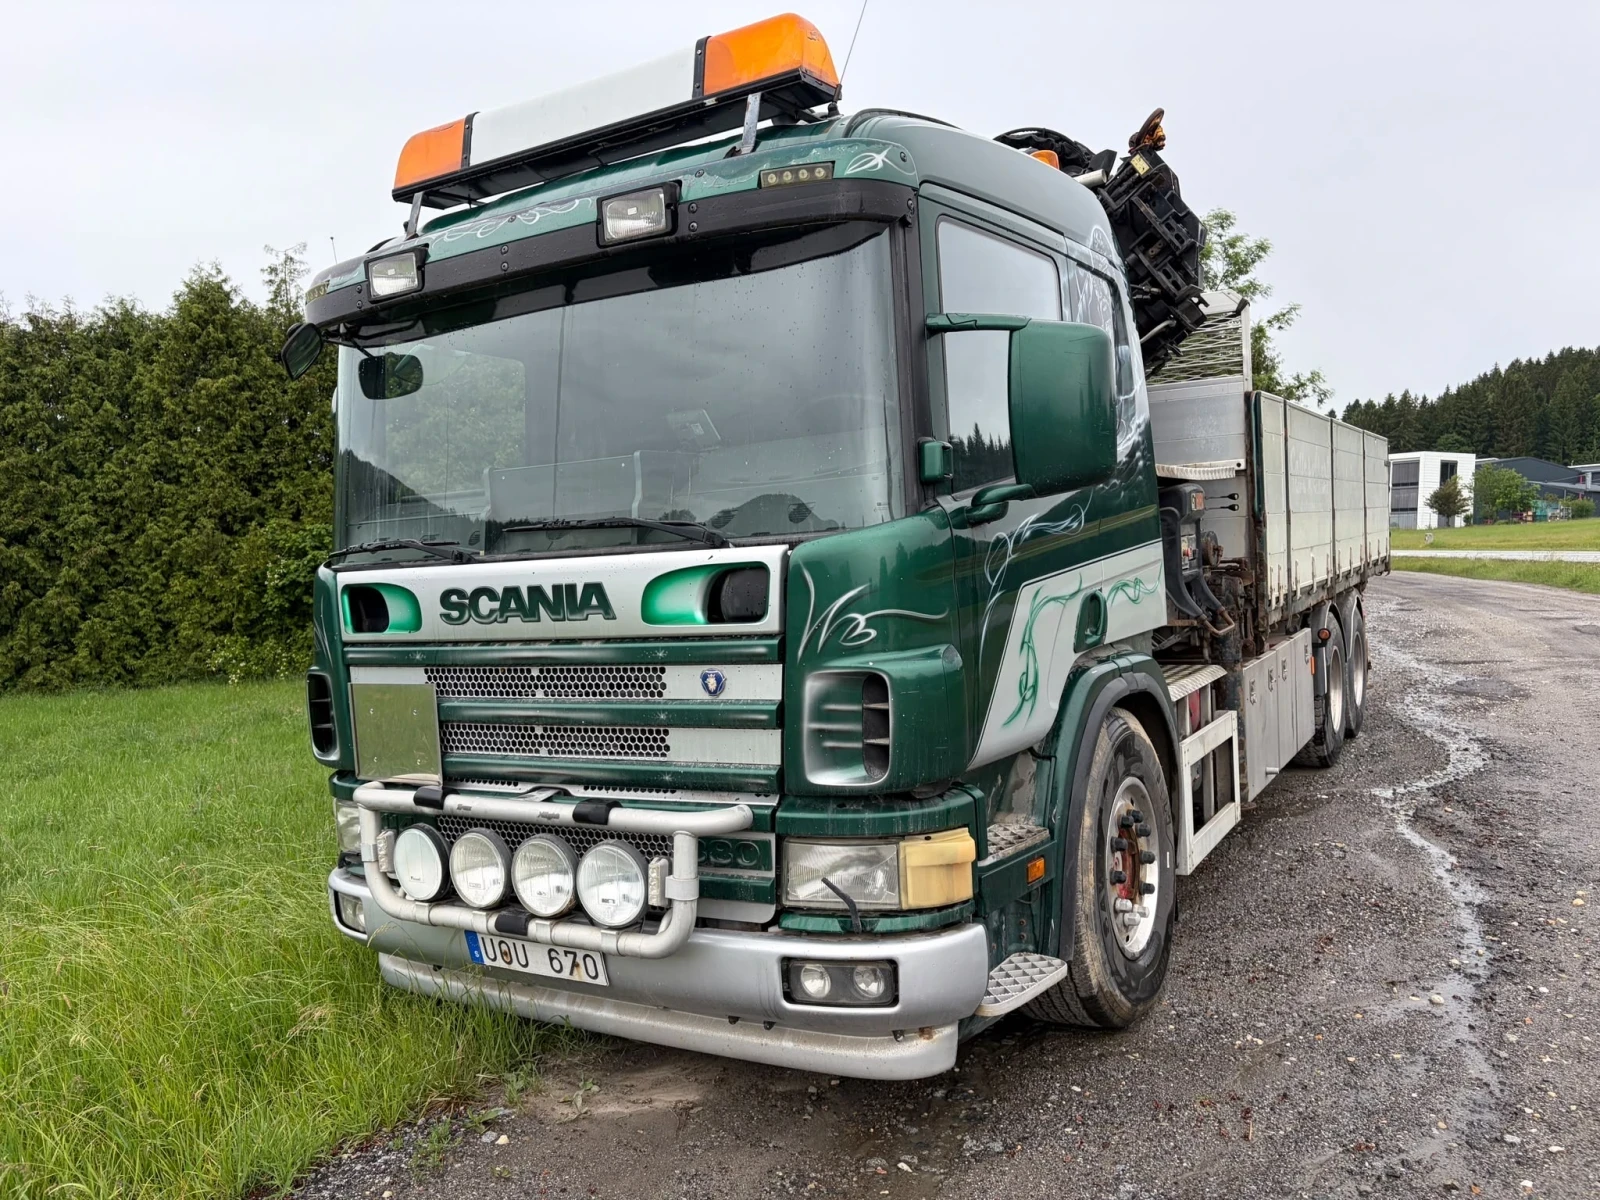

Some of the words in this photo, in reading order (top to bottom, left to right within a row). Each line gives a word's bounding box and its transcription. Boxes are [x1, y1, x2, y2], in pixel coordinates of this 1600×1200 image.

[439, 582, 617, 625] SCANIA
[474, 950, 480, 958] S
[481, 936, 529, 968] UOU
[547, 948, 599, 980] 670
